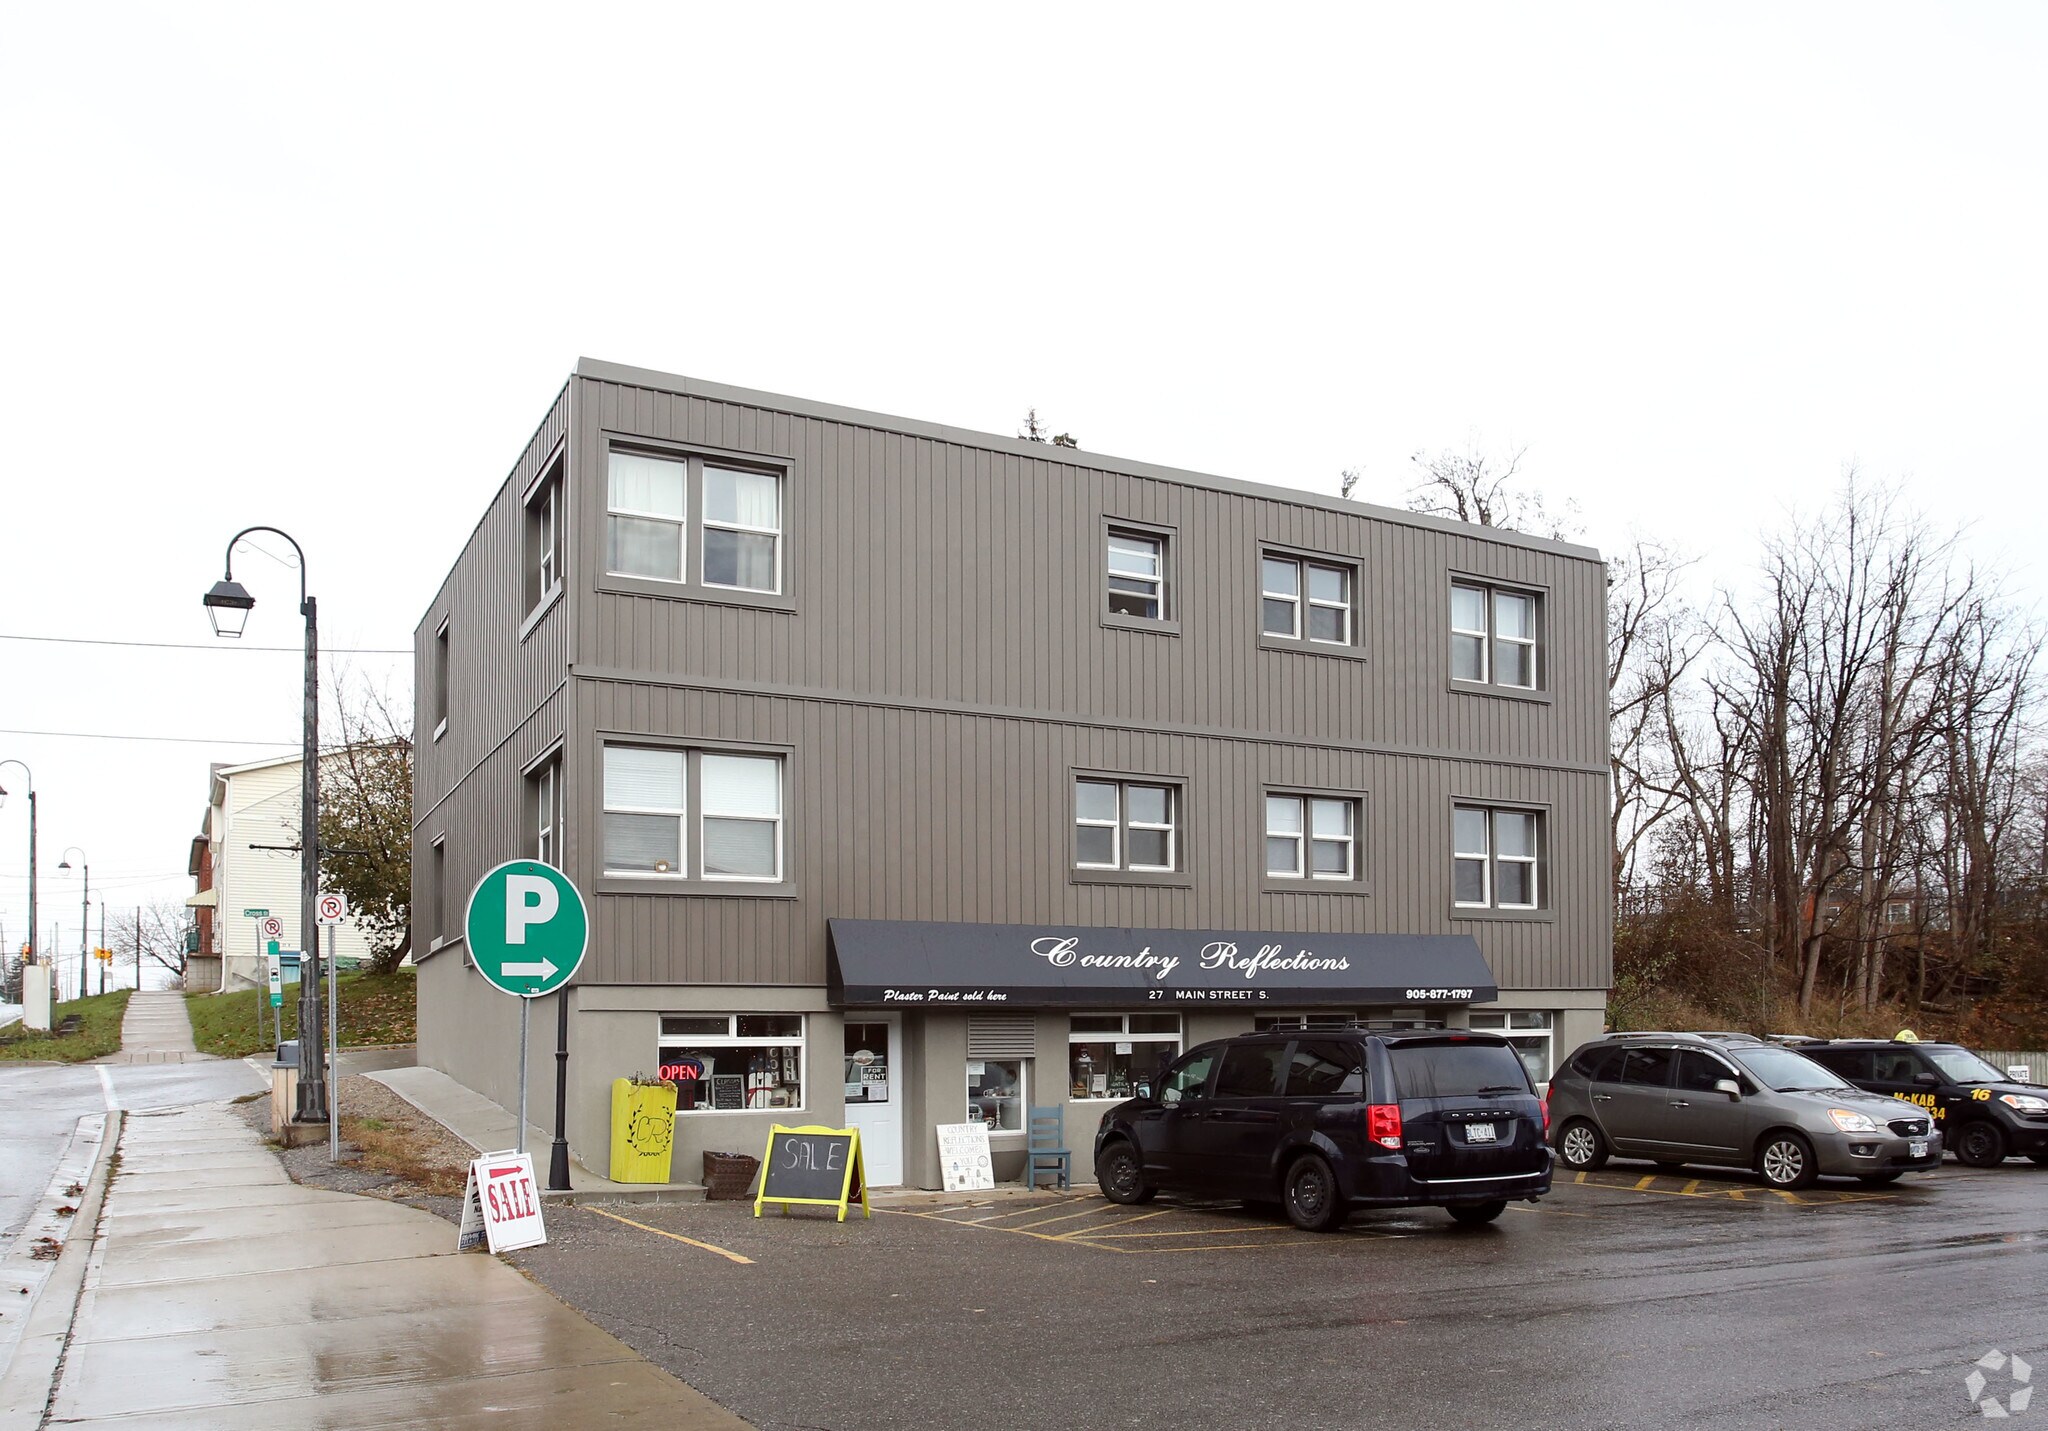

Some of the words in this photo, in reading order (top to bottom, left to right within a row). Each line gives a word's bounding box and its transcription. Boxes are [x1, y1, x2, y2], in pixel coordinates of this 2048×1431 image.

[506, 874, 560, 945] P
[1030, 936, 1180, 980] Country
[1199, 941, 1350, 979] Reflections
[883, 989, 924, 1002] Plaster
[927, 989, 960, 1002] Paint
[962, 990, 984, 1001] sold
[986, 990, 1007, 1001] here
[1148, 990, 1164, 999] 27
[1175, 990, 1205, 999] MAIN
[1209, 990, 1253, 999] STREET
[1258, 990, 1270, 999] S.
[1405, 989, 1473, 999] 905-877-1797
[659, 1064, 699, 1081] OPEN
[1893, 1092, 1936, 1107] McKAB
[1970, 1088, 1992, 1101] 16
[947, 1125, 978, 1134] COUNTRY
[943, 1135, 985, 1145] REFLECTIONS
[782, 1138, 842, 1171] SALE
[944, 1145, 984, 1154] WELCOMES
[487, 1178, 536, 1223] SALE
